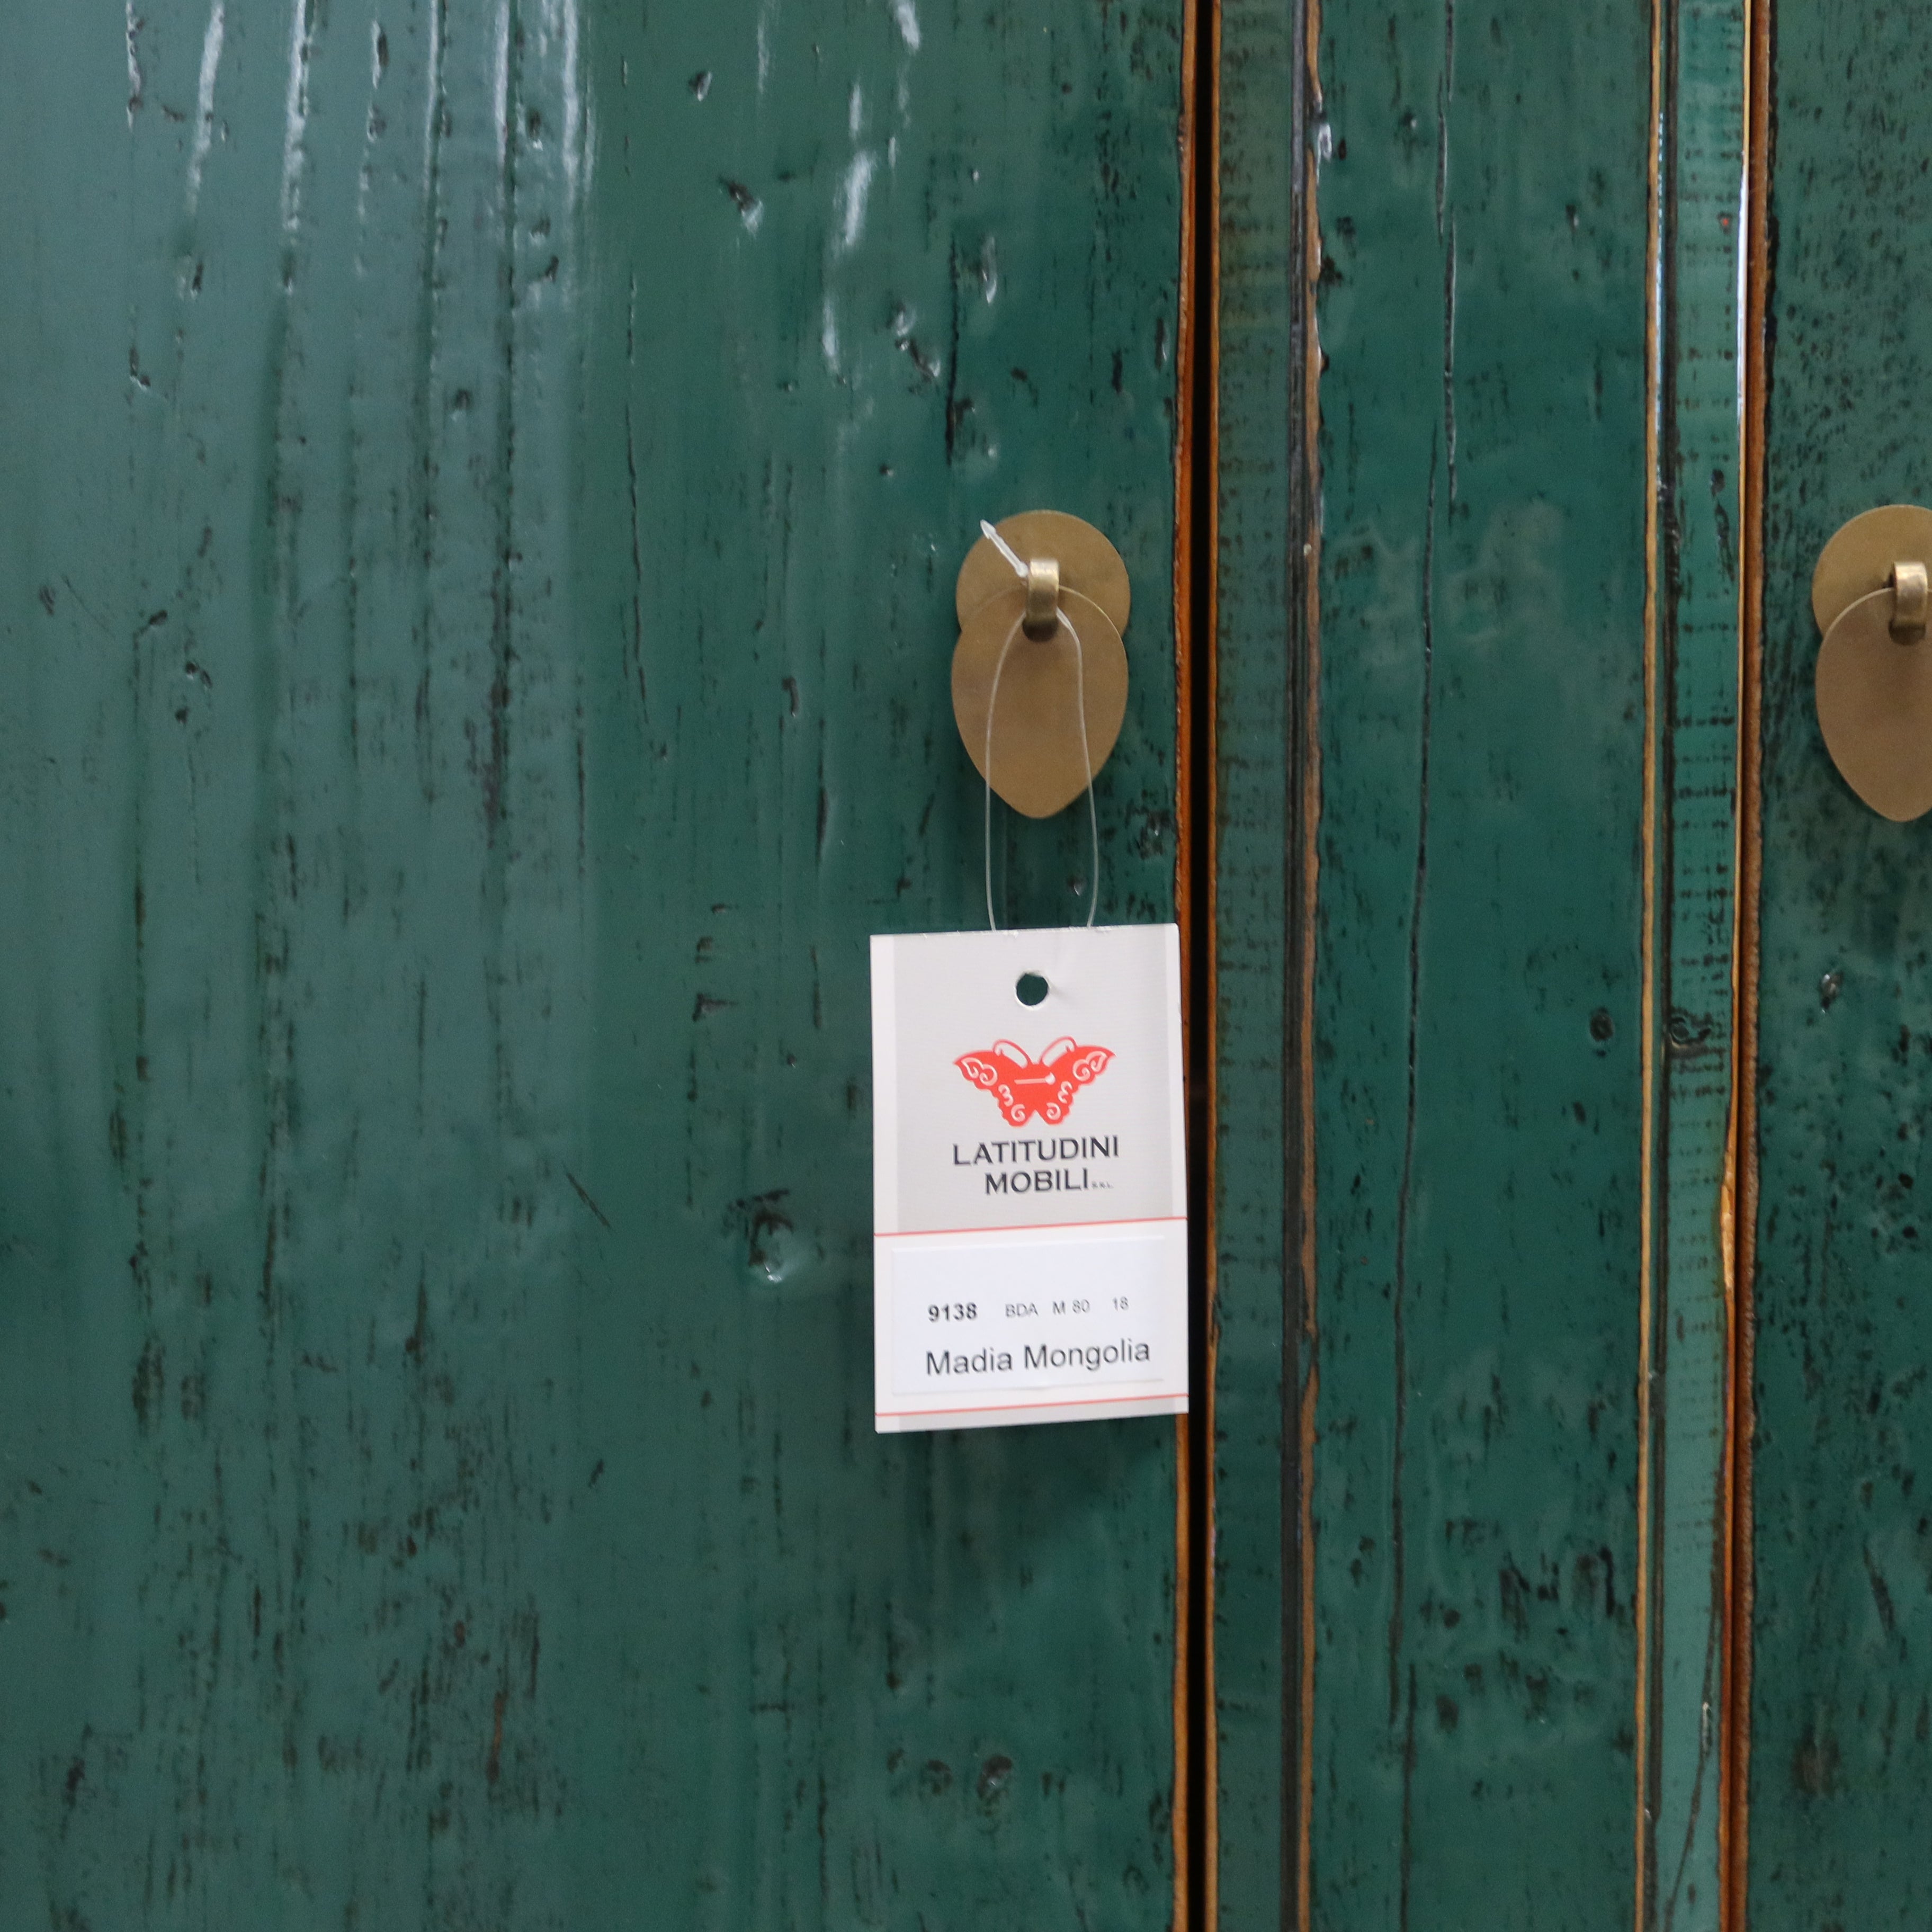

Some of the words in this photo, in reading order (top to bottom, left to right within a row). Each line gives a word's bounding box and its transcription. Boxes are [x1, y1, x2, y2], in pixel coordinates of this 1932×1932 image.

[953, 1135, 1119, 1165] LATITUDINI
[985, 1168, 1088, 1194] MOBILI
[928, 1302, 977, 1322] 9138
[1005, 1302, 1039, 1318] BDA
[1052, 1301, 1066, 1315] M
[1072, 1299, 1090, 1314] 80
[1113, 1296, 1129, 1311] 18
[926, 1347, 1013, 1375] Madia
[1024, 1338, 1150, 1372] Mongolia
